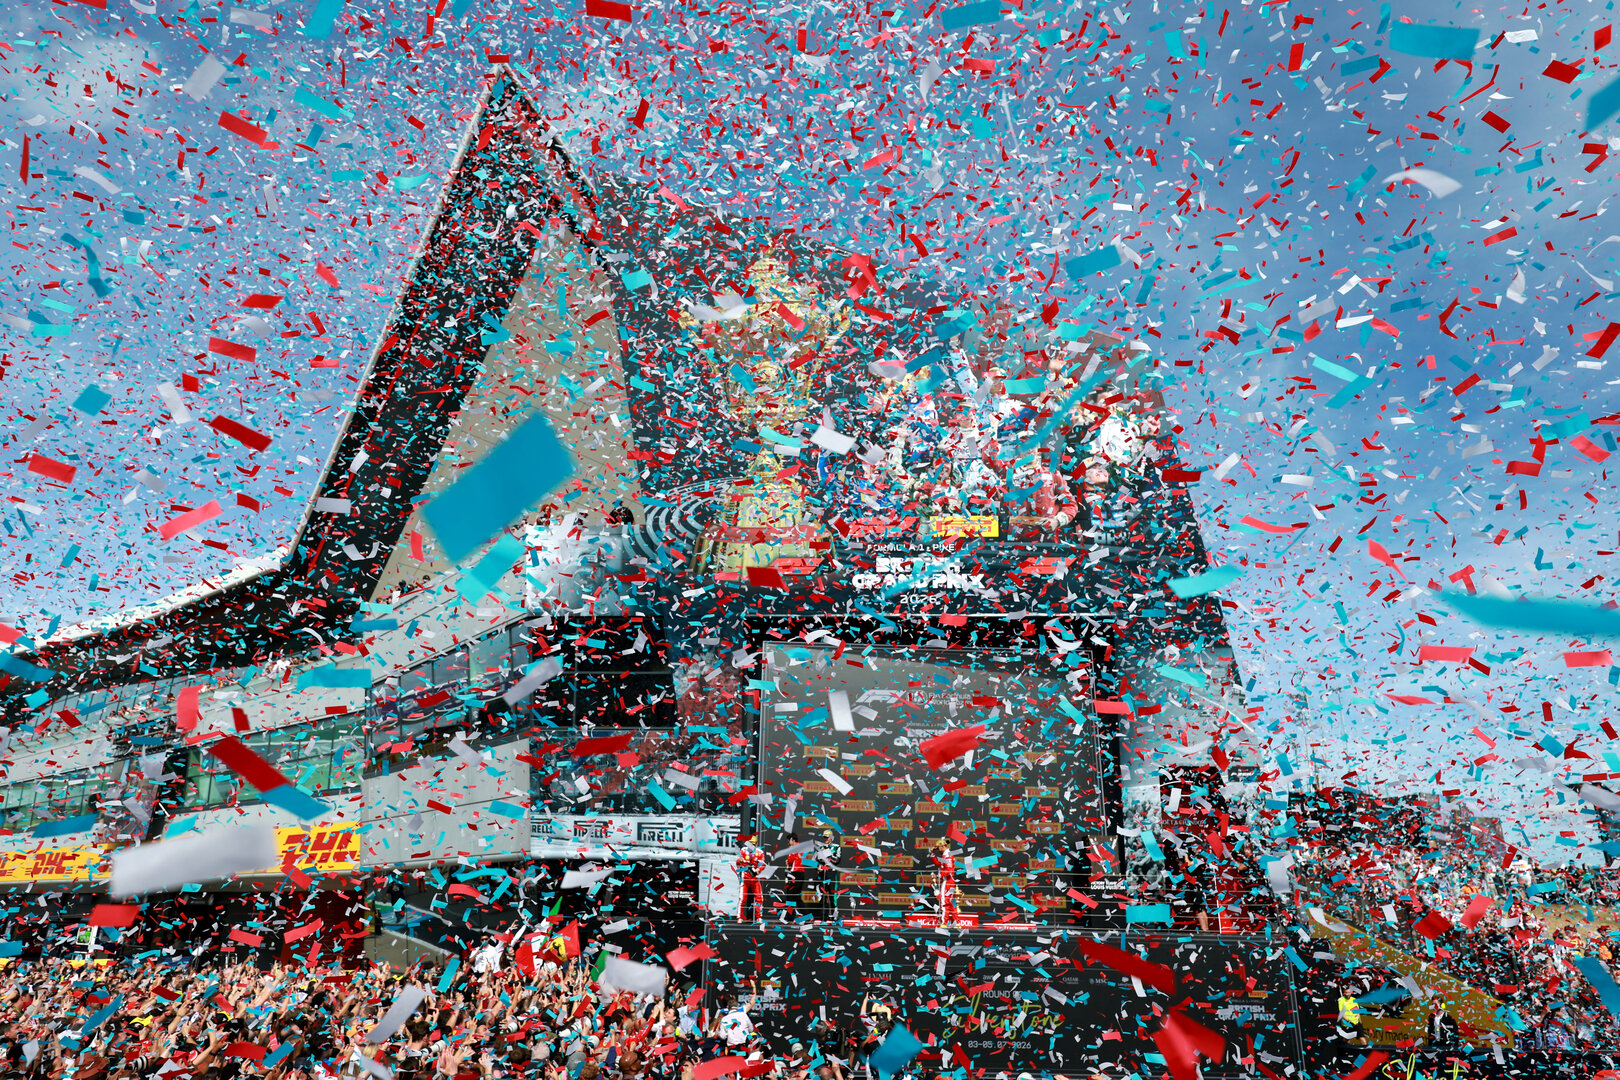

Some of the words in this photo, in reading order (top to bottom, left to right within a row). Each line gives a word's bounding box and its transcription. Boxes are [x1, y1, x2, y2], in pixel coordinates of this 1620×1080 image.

[867, 543, 917, 552] FORMUA
[932, 543, 969, 552] PIRELI
[900, 595, 937, 604] 2026
[574, 820, 609, 838] PIRLLI
[637, 822, 683, 842] PIRELLI
[282, 830, 358, 865] DHL
[32, 852, 68, 875] DHL
[763, 1003, 787, 1011] PRIX
